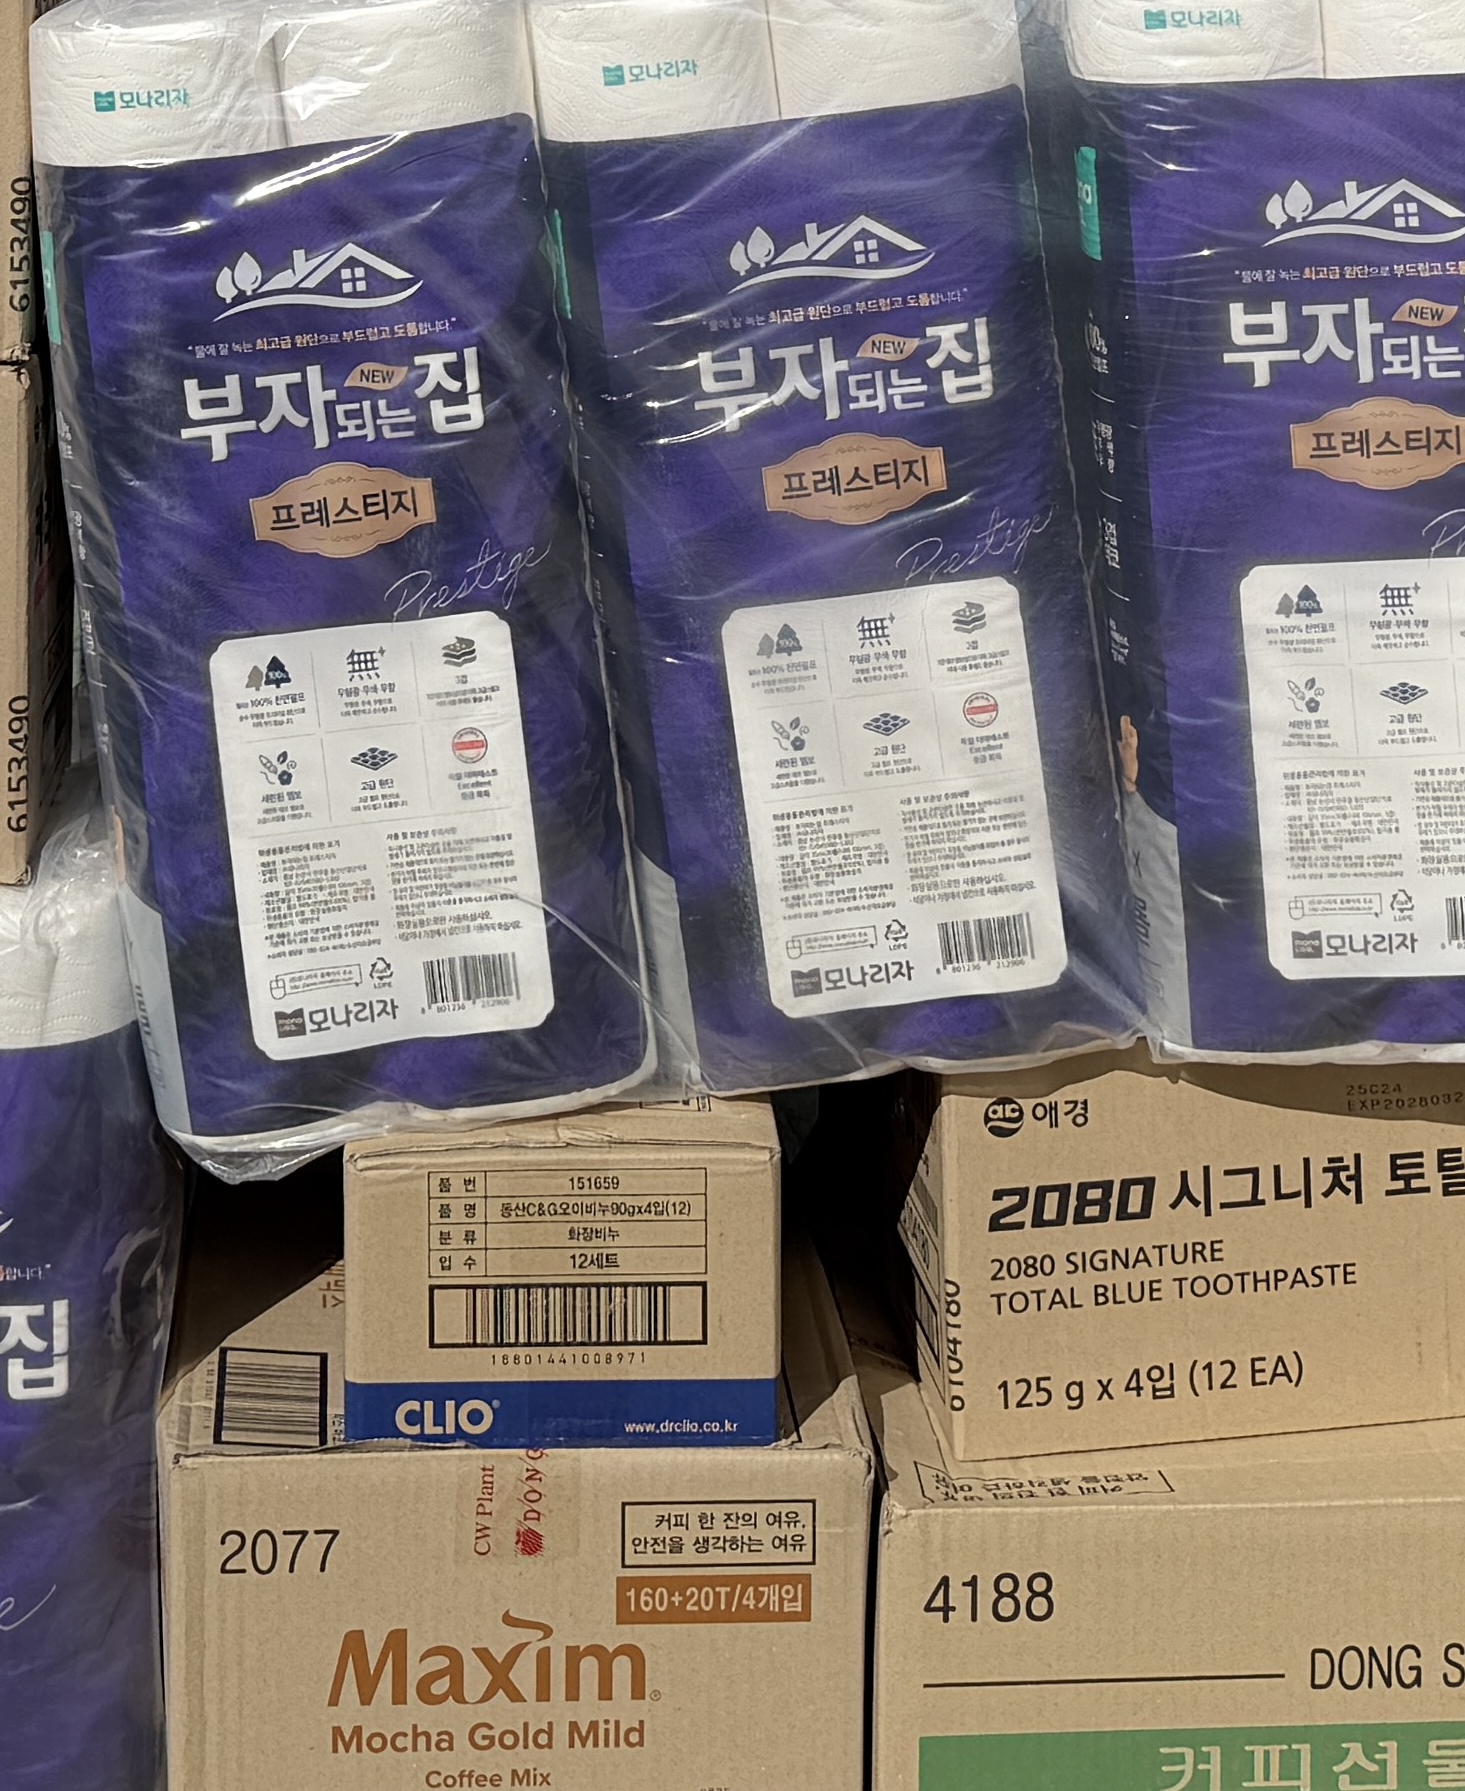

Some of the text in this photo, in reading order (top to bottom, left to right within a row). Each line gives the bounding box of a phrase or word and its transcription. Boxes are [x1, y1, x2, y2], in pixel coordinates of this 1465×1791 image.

[628, 58, 698, 84] 모나리자
[1407, 304, 1445, 322] NEW
[870, 339, 907, 356] NEW
[358, 367, 396, 385] NEW
[1309, 424, 1464, 461] 프레스티지
[780, 455, 930, 501] 프레스티지
[269, 493, 419, 534] 프레스티지
[1325, 932, 1419, 957] 모나리자
[824, 959, 915, 992] 모나리자
[308, 998, 399, 1034] 모나리자
[1031, 1097, 1091, 1130] 애경
[568, 1175, 620, 1191] 151659
[987, 1176, 1157, 1234] 2080
[1167, 1152, 1364, 1218] 시그니처
[567, 1225, 621, 1243] 화장비누
[568, 1252, 621, 1270] 12세트
[989, 1239, 1225, 1282] 2080 SIGNATURE
[990, 1262, 1358, 1317] TOTAL BLUE TOOTHPASTE
[996, 1376, 1053, 1411] 125
[1123, 1362, 1178, 1401] 4입
[1188, 1360, 1238, 1398] (12
[394, 1398, 495, 1436] CLIO
[473, 1464, 495, 1556] CW Plant
[654, 1512, 690, 1531] 커피
[697, 1511, 715, 1530] 한
[722, 1511, 758, 1530] 잔의
[218, 1528, 341, 1576] 2077
[631, 1534, 807, 1555] 안전을 생각하는 여유
[625, 1583, 804, 1613] 160+20T/4개입
[923, 1572, 1055, 1624] 4188
[326, 1608, 648, 1708] Maxim
[1309, 1644, 1423, 1692] DONG
[330, 1719, 646, 1755] Mocha Gold Mild
[424, 1767, 552, 1790] Coffee Mix
